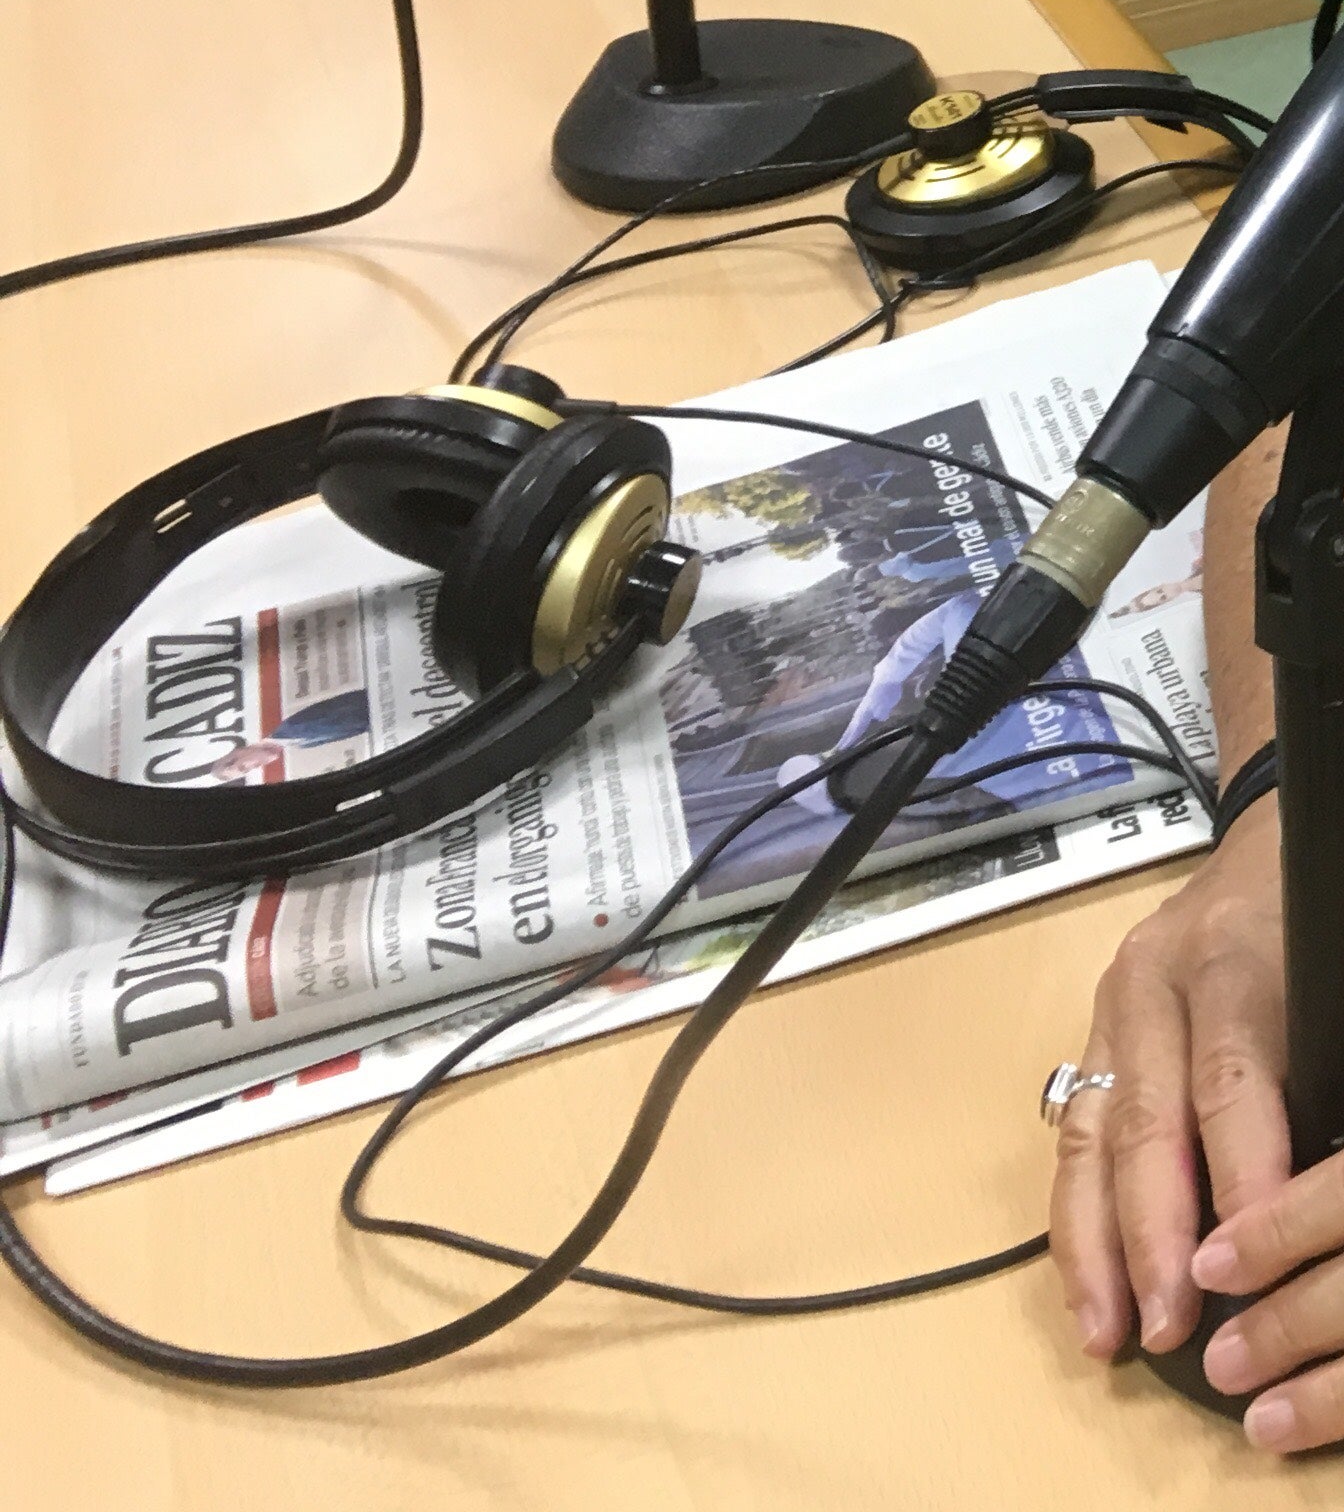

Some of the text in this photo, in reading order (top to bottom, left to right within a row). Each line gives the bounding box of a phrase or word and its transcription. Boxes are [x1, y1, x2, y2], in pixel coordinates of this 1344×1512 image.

[938, 491, 974, 517] de
[952, 518, 990, 557] mar
[966, 556, 1000, 584] un
[1139, 629, 1184, 691] urbana
[1022, 695, 1067, 752] irge
[1165, 689, 1212, 739] playa
[1046, 756, 1080, 778] a
[1108, 815, 1141, 843] La
[424, 880, 482, 971] Zona
[504, 885, 554, 945] en
[619, 894, 642, 919] de
[112, 879, 246, 1057] DIARIO
